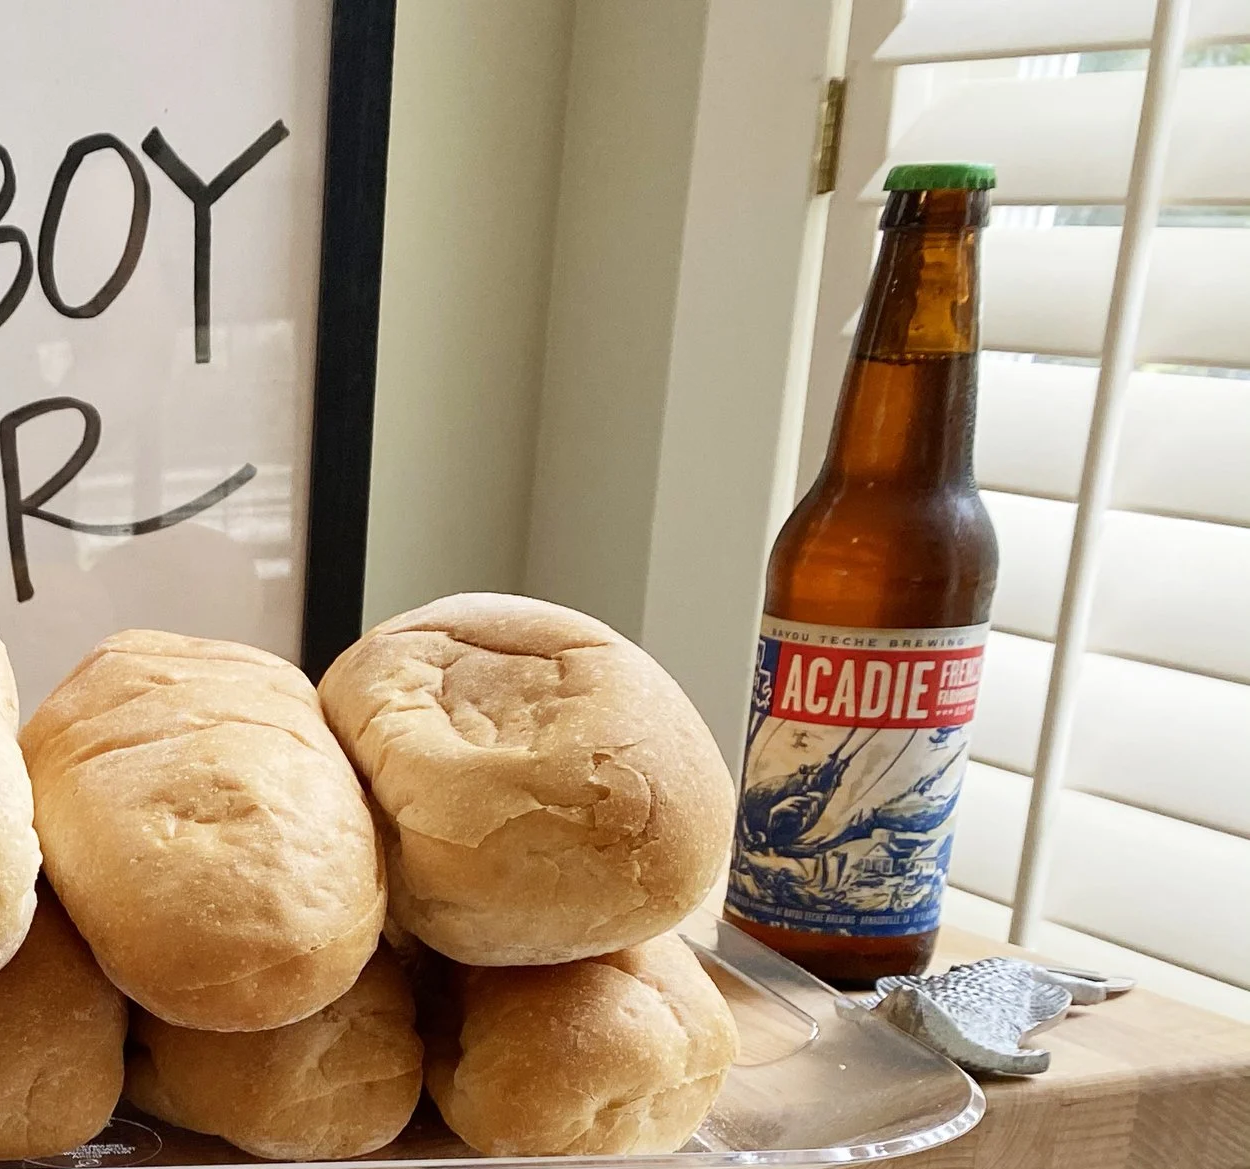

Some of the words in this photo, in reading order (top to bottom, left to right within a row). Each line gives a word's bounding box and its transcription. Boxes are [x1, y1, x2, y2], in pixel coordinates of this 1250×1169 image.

[772, 628, 810, 642] BAYOU
[820, 634, 878, 647] TECHE
[889, 636, 965, 648] BREWING
[781, 653, 936, 719] ACADIE
